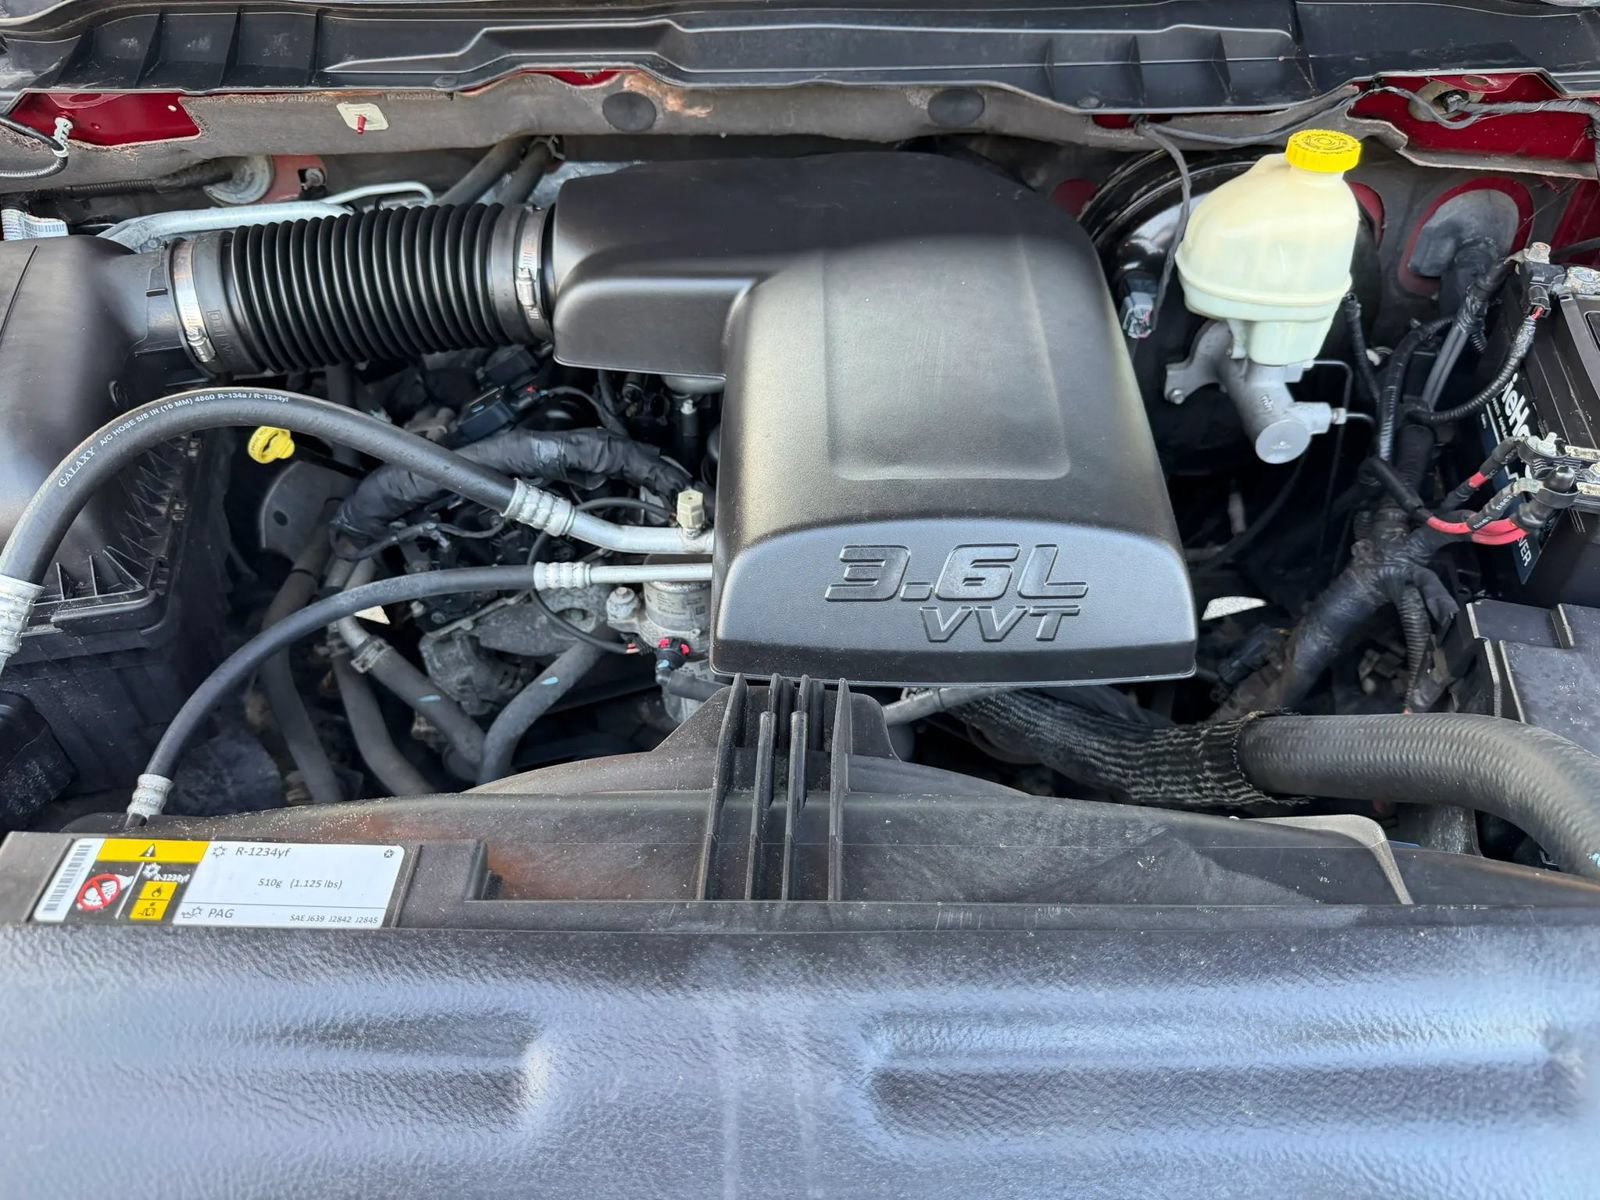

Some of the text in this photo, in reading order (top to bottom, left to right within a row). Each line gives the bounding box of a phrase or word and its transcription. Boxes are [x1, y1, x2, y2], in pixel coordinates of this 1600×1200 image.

[58, 446, 96, 488] GALAXY
[100, 433, 113, 446] A/C
[113, 419, 137, 437] HOSE
[136, 412, 149, 423] 5/8
[150, 407, 161, 416] IN
[160, 403, 173, 413] (16
[175, 397, 193, 408] MM)
[195, 394, 216, 403] 4860
[253, 392, 290, 403] R-1234yf
[1517, 536, 1532, 567] VER
[825, 543, 1089, 601] 3.6L
[919, 605, 1081, 642] VVT
[235, 846, 292, 859] R-1234yf
[257, 878, 343, 890] 510g (1.125 lbs)
[207, 908, 379, 925] PAG SAE J639 J2842 J2845
